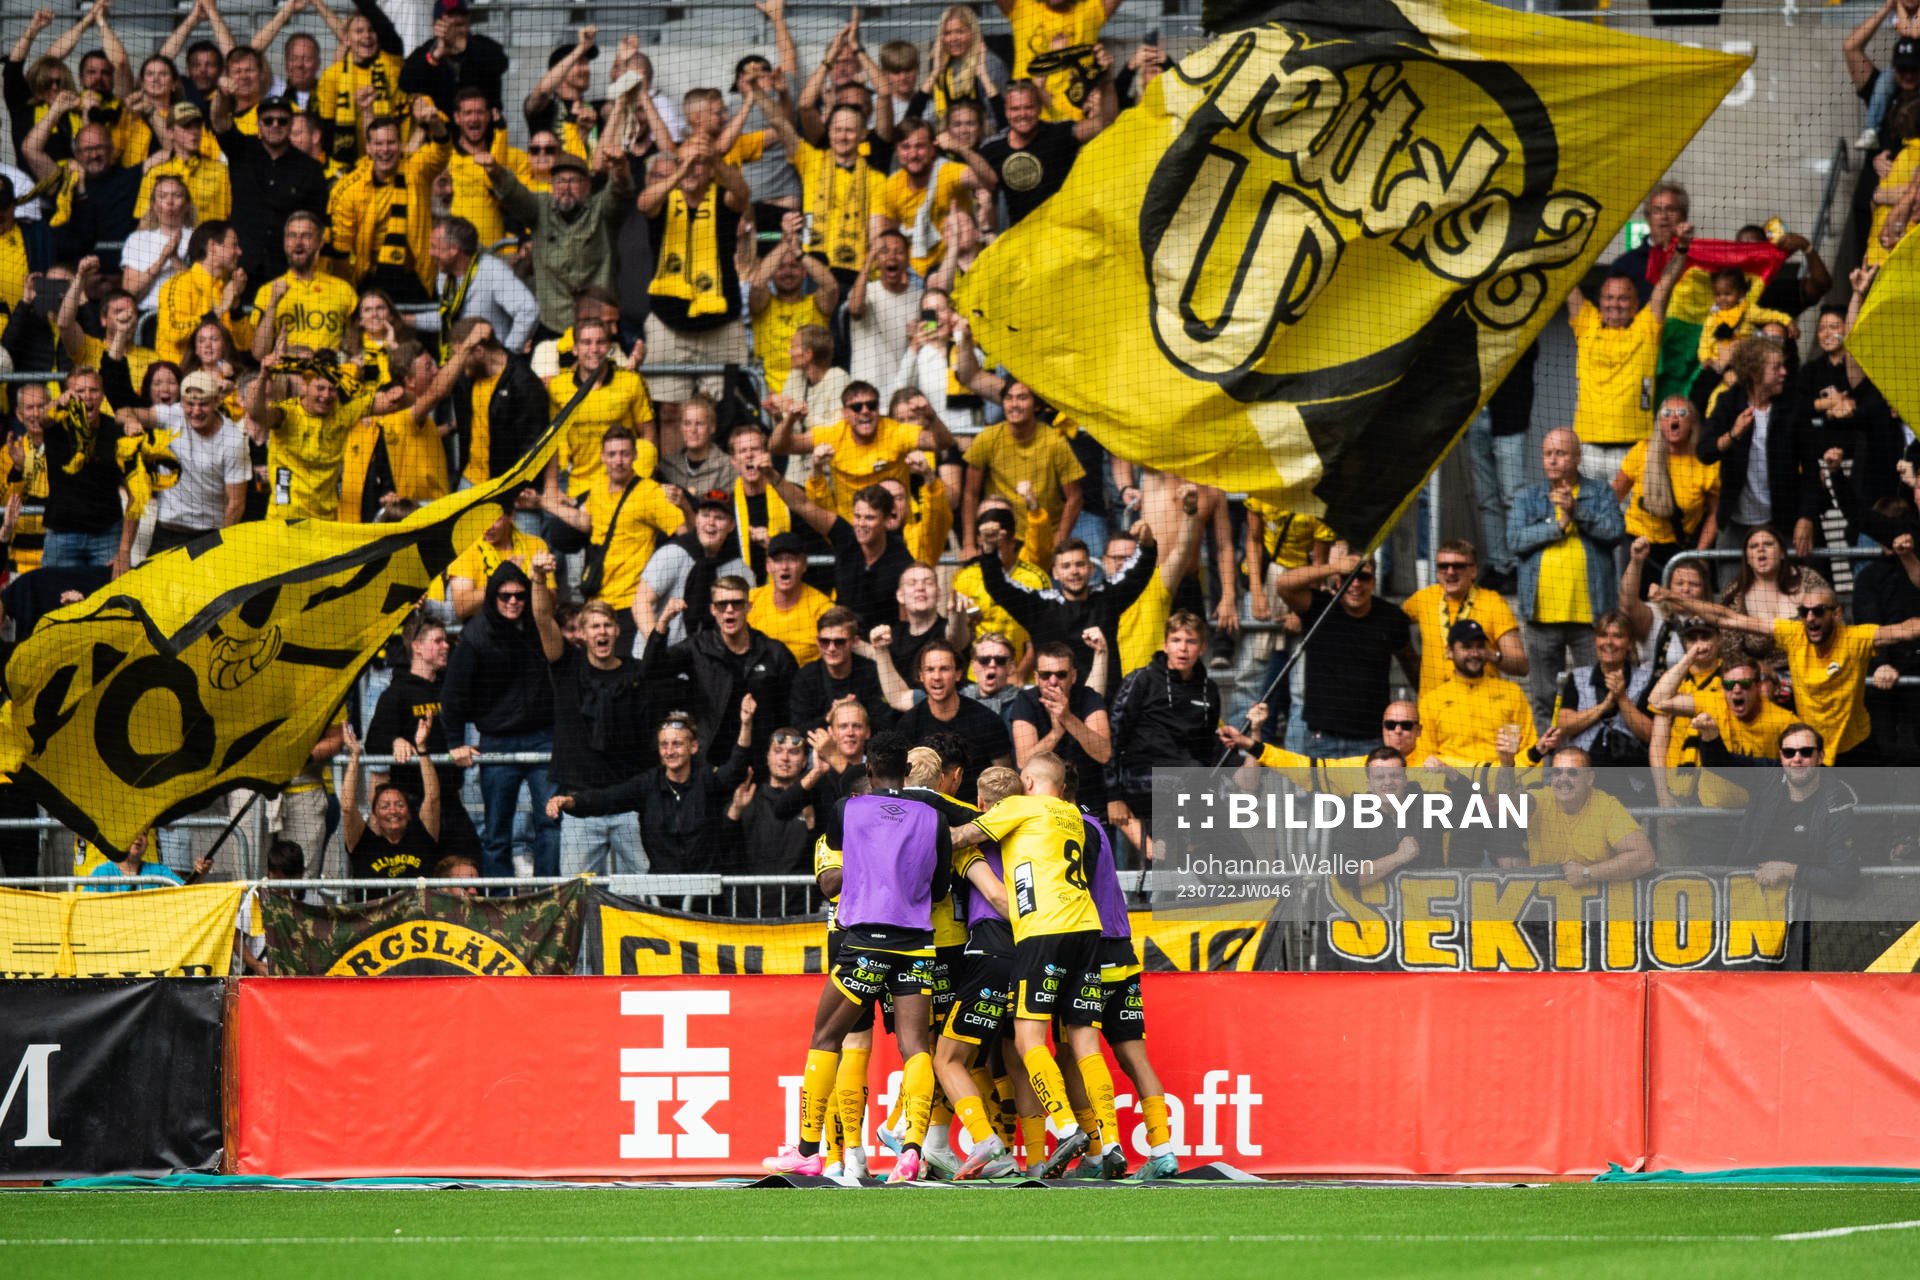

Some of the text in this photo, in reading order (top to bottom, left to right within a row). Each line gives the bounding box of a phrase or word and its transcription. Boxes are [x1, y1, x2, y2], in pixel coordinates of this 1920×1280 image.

[279, 303, 340, 334] ellos
[1063, 839, 1088, 891] 8
[1325, 871, 1797, 973] SEKTION
[345, 926, 516, 975] RGSLÄK
[856, 969, 884, 982] EAB
